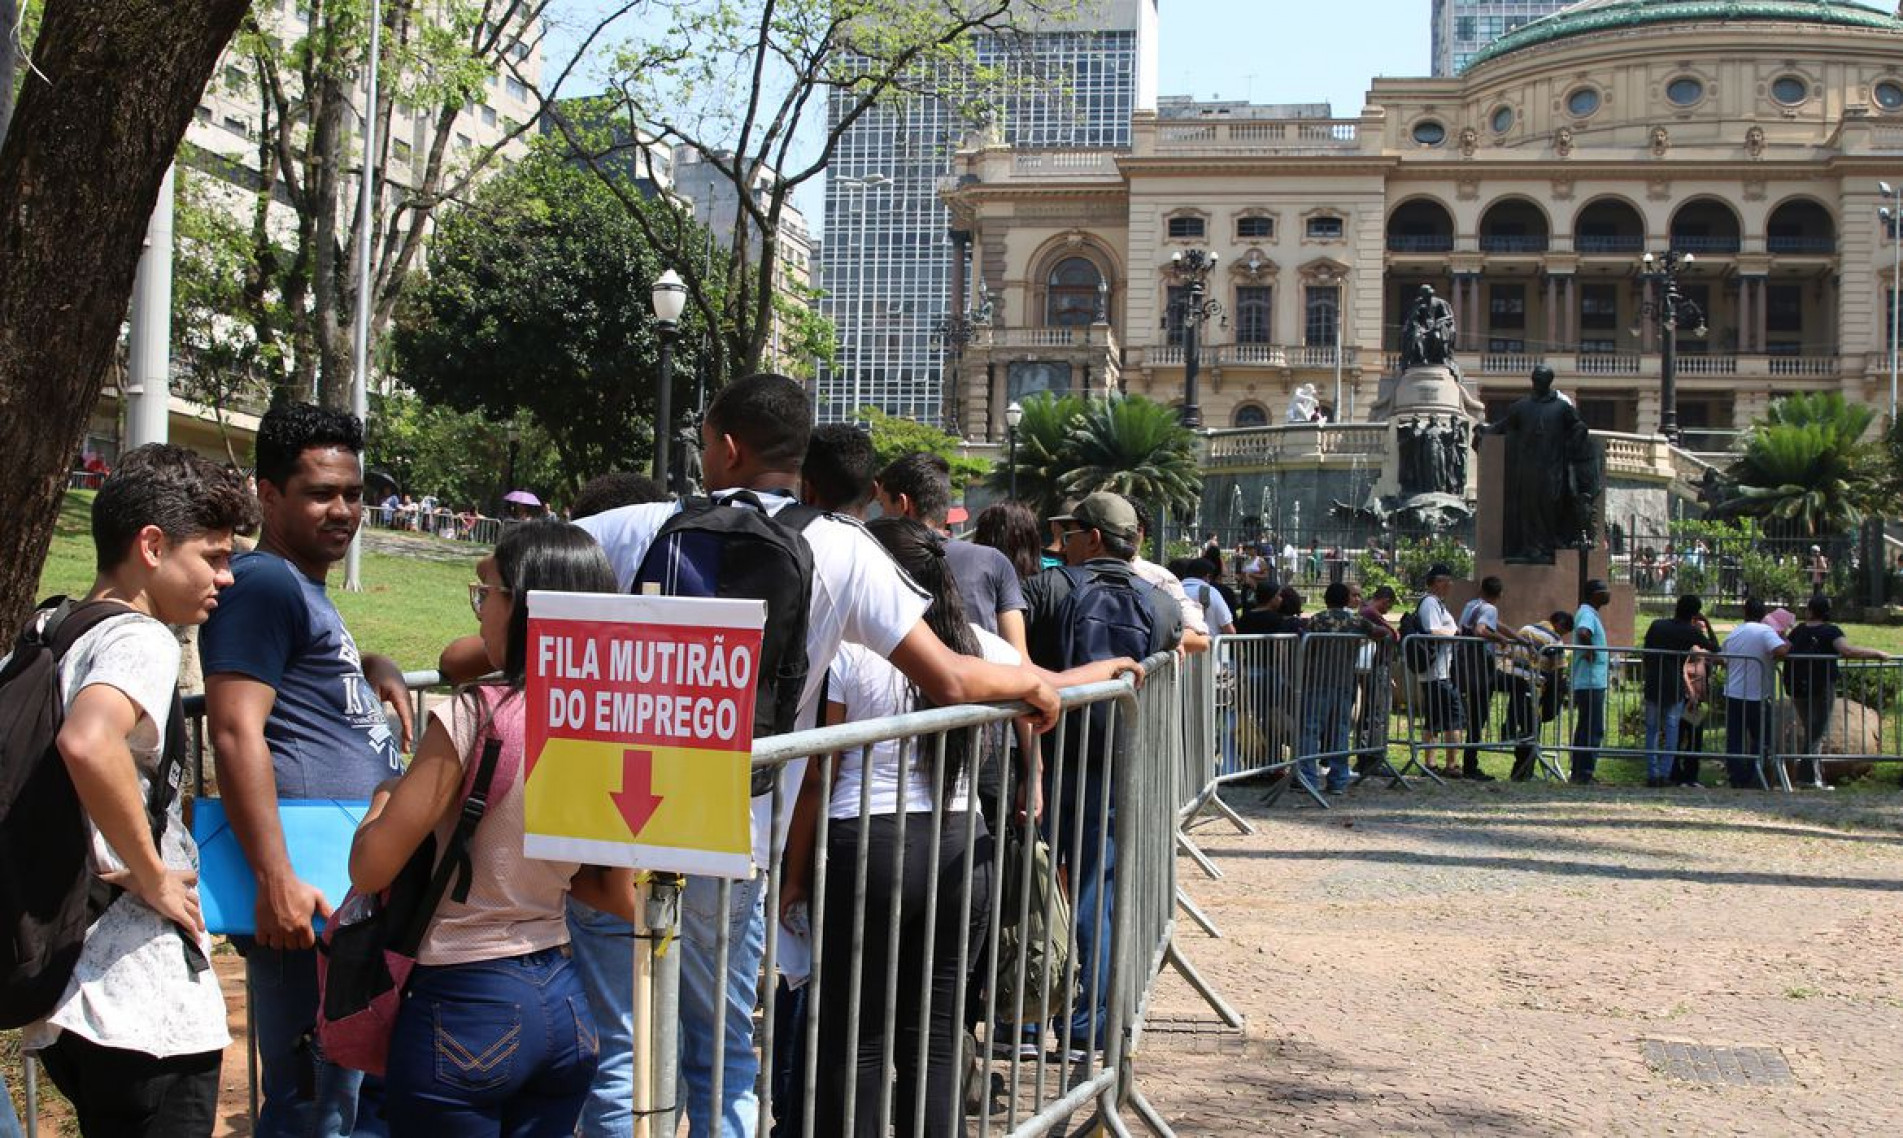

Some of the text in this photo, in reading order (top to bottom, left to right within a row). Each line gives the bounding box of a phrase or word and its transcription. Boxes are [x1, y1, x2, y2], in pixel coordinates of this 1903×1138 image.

[538, 634, 751, 689] FILA MUTIRÃO
[549, 688, 737, 741] DO EMPREGO
